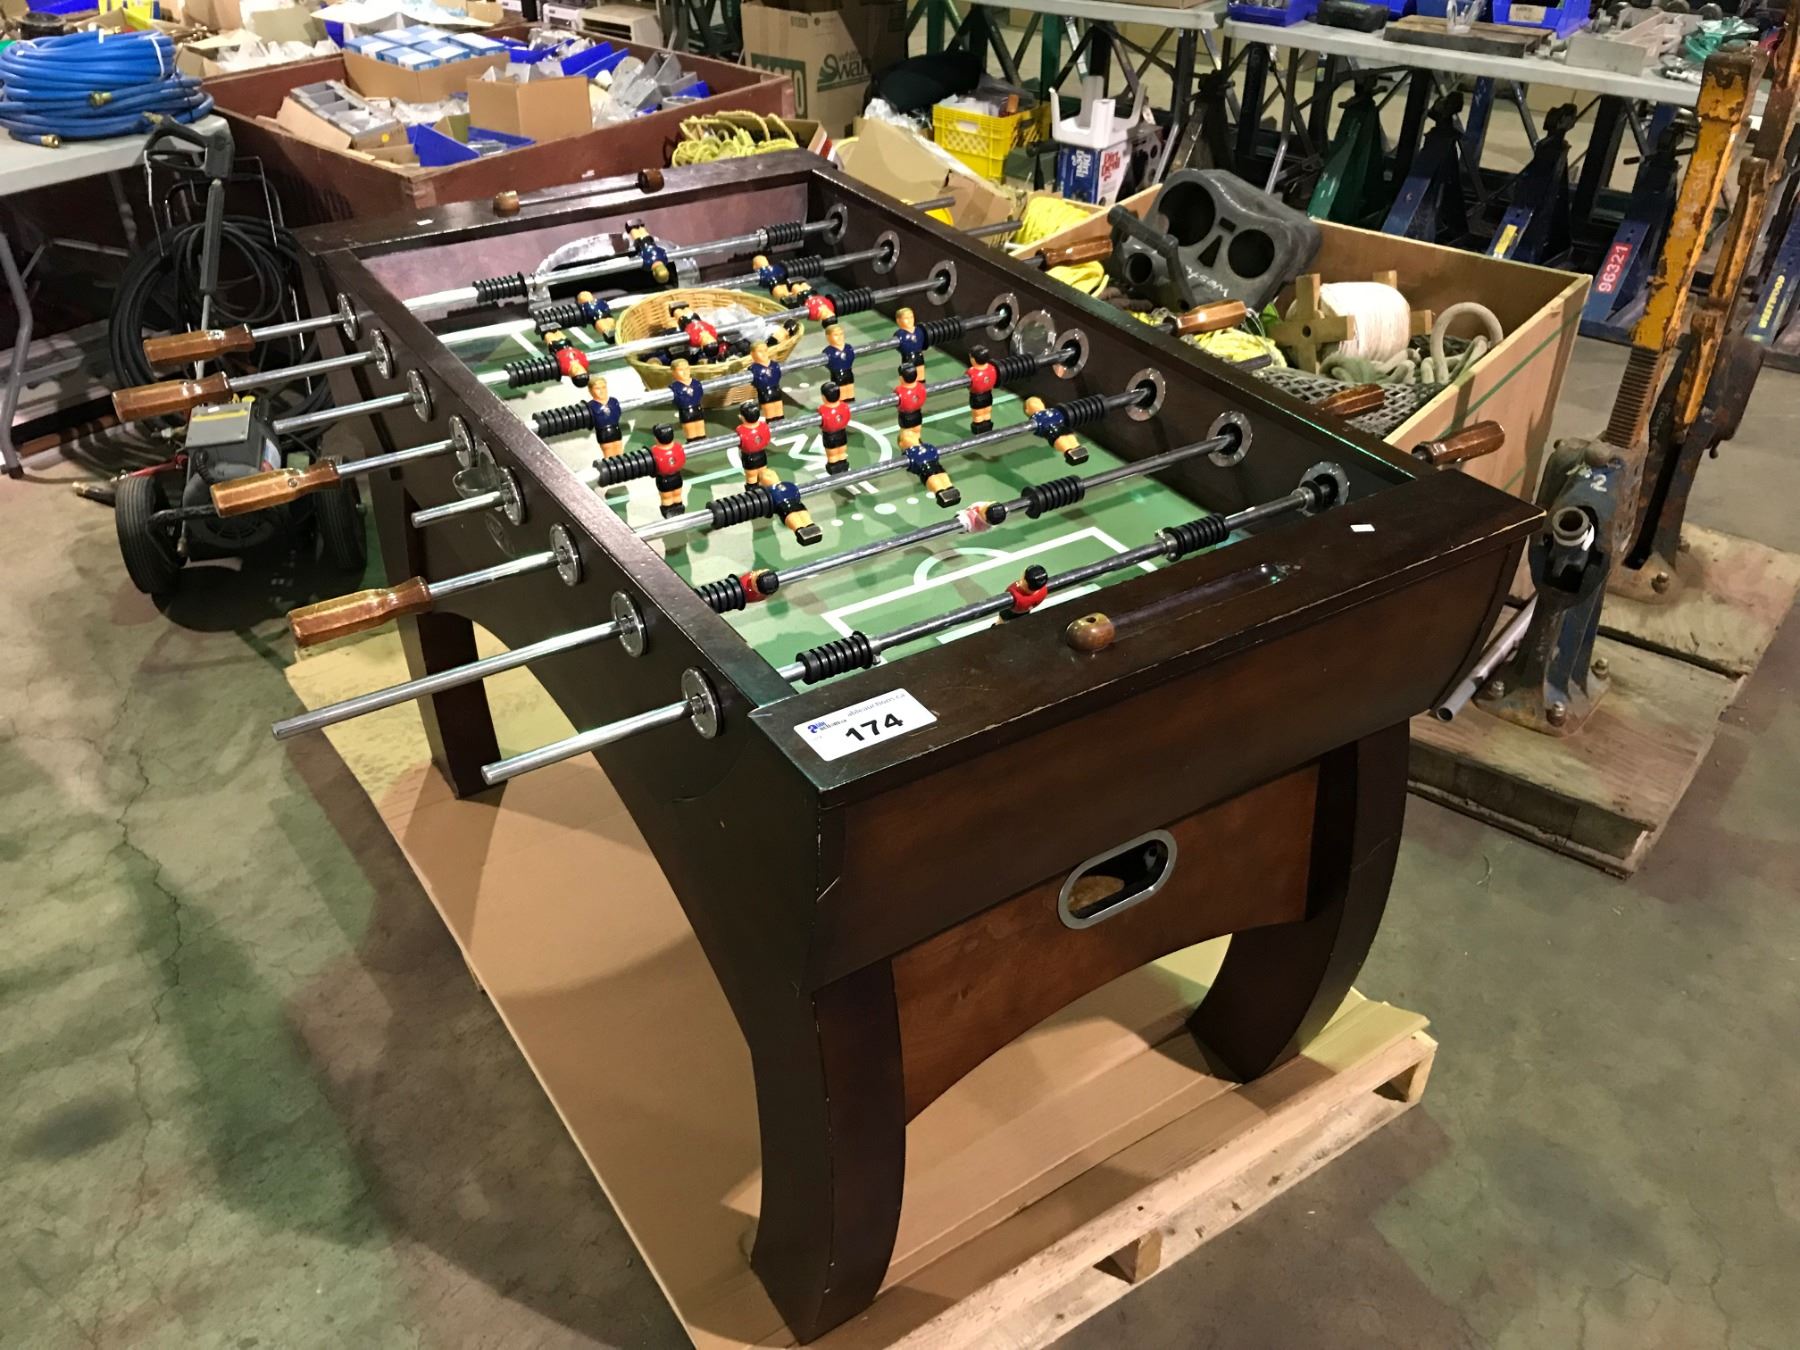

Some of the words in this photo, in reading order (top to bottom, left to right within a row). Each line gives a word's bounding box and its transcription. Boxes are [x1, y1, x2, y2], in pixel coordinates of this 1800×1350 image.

[1598, 243, 1630, 293] 96321
[1590, 474, 1608, 493] 2
[845, 713, 904, 741] 174
